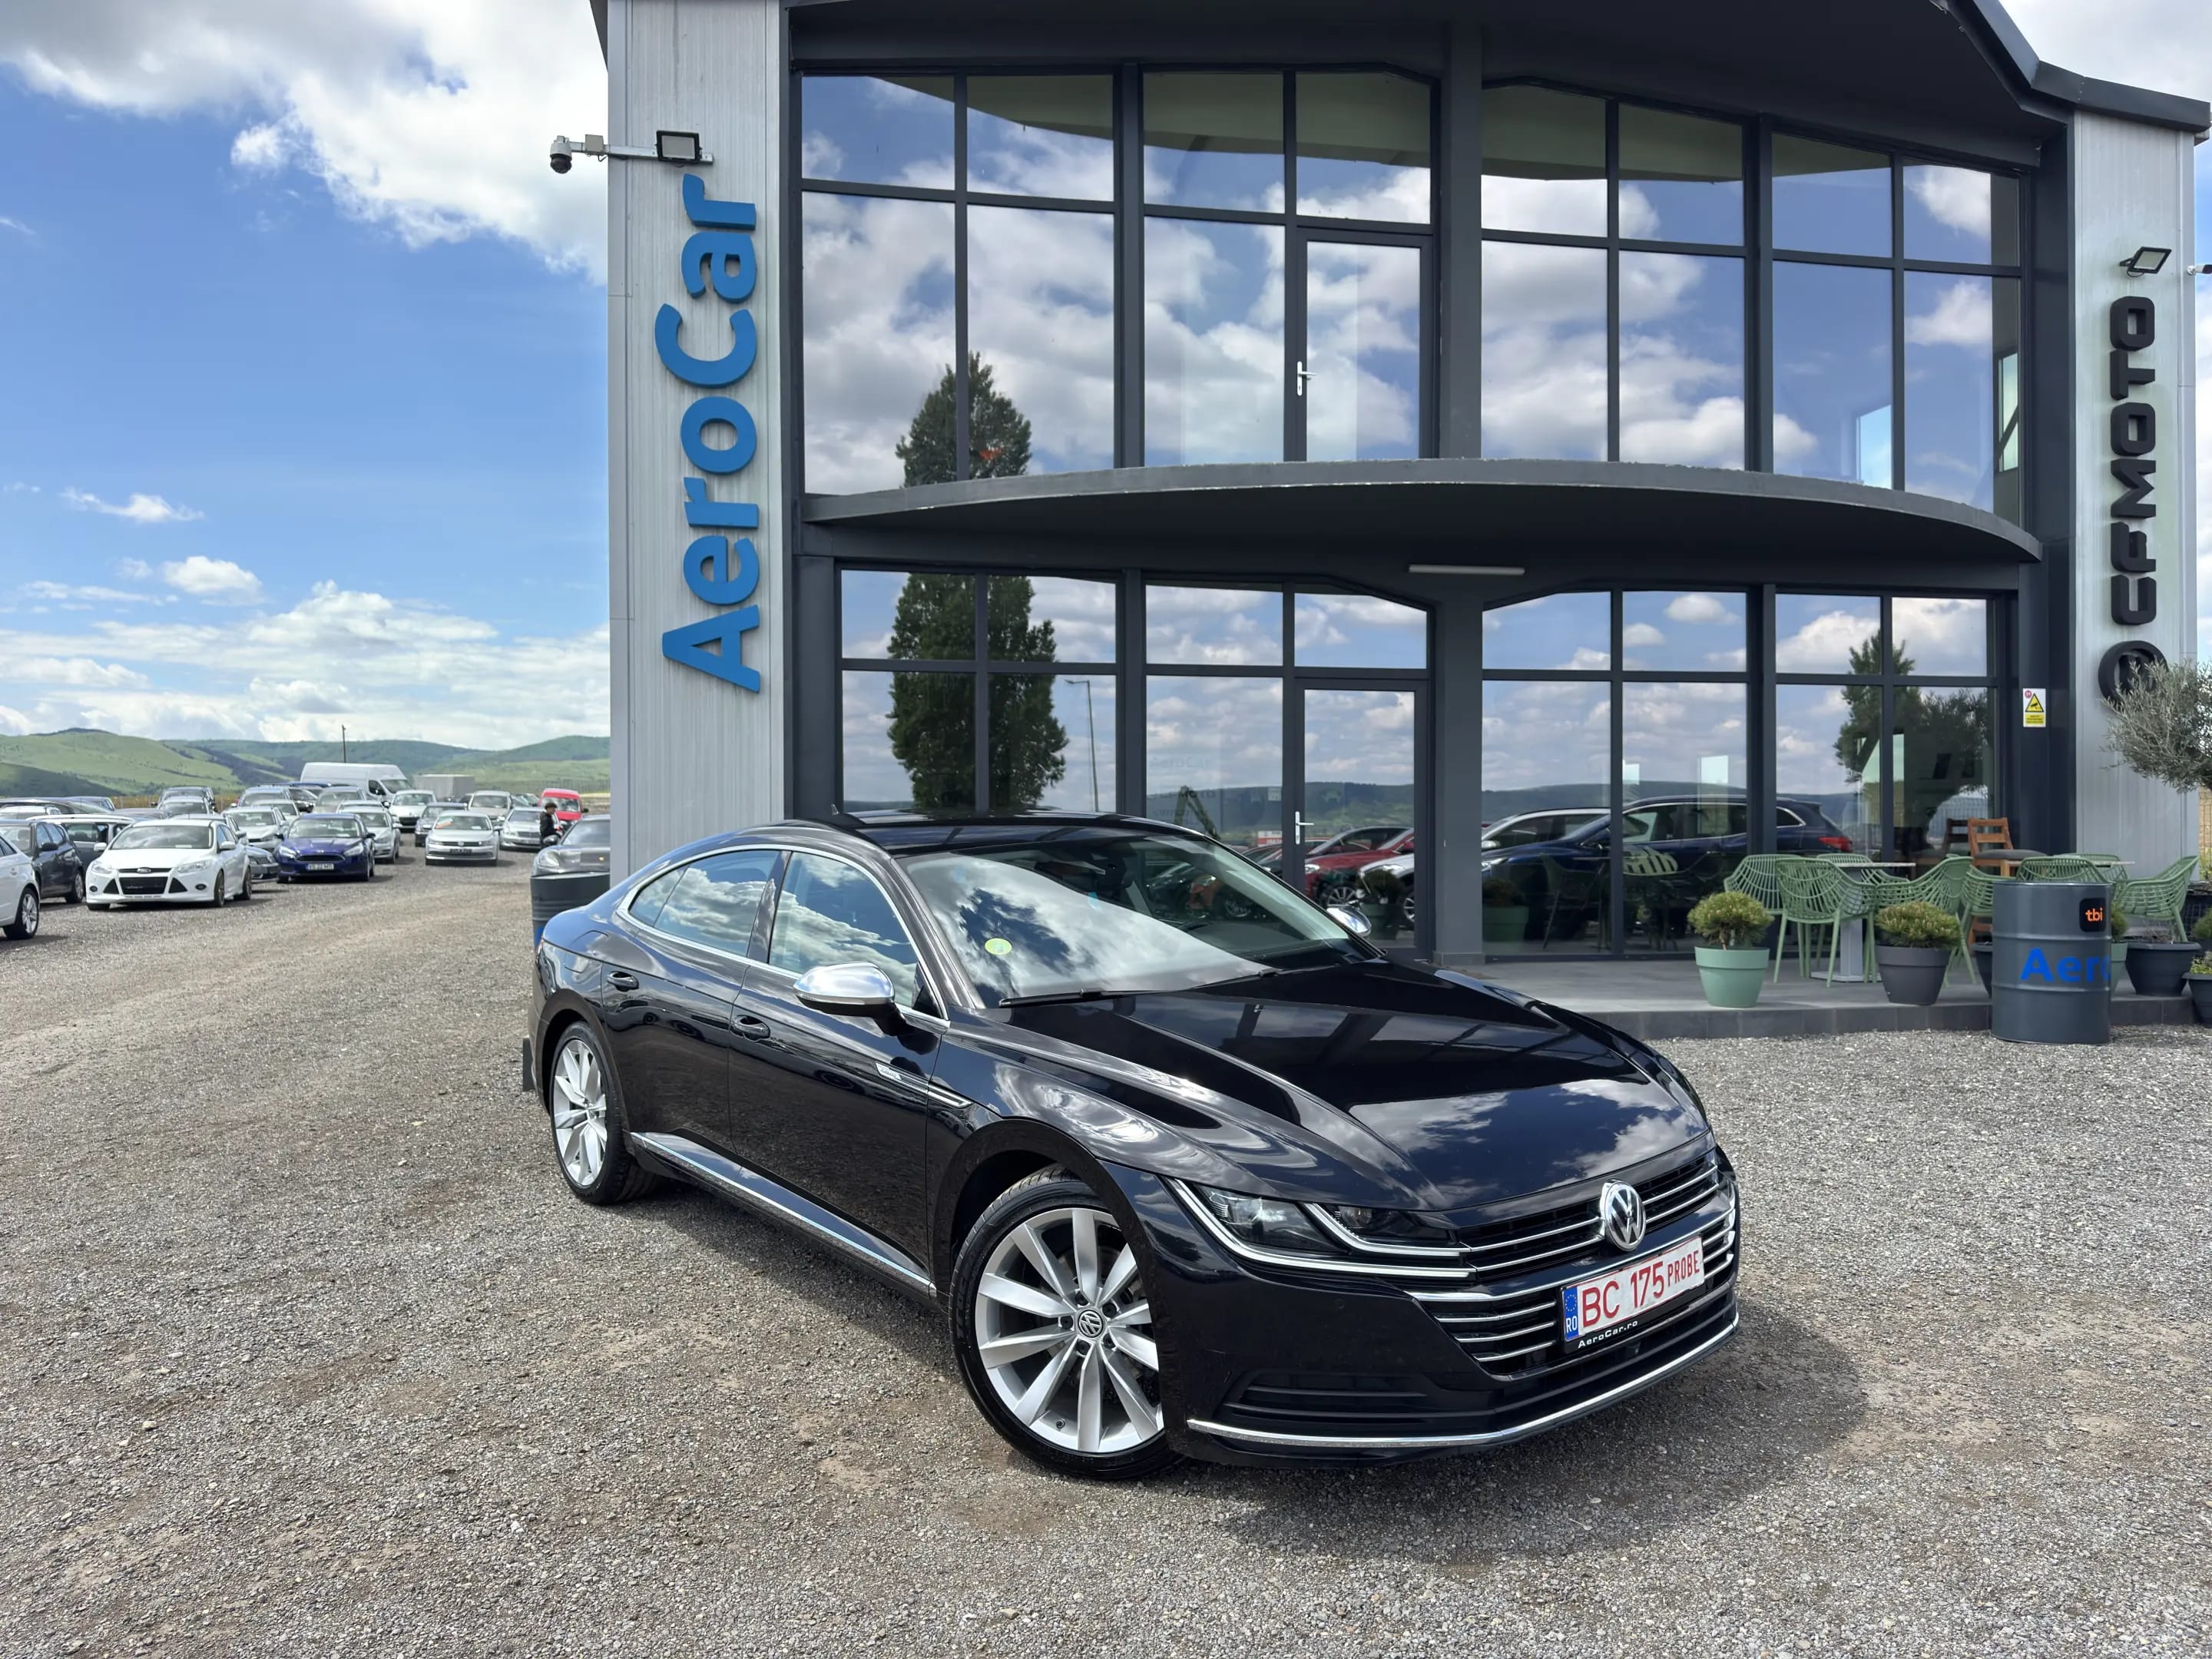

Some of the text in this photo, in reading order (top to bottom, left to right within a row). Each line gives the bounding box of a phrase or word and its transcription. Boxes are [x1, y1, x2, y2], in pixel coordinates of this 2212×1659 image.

[654, 174, 760, 694] AeroCar
[2110, 296, 2157, 625] CFMOTO
[2085, 907, 2103, 922] tbi
[1582, 1250, 1700, 1328] BC 175 PROBE
[1566, 1316, 1578, 1333] RO
[1578, 1320, 1638, 1349] AeroCar.ro
